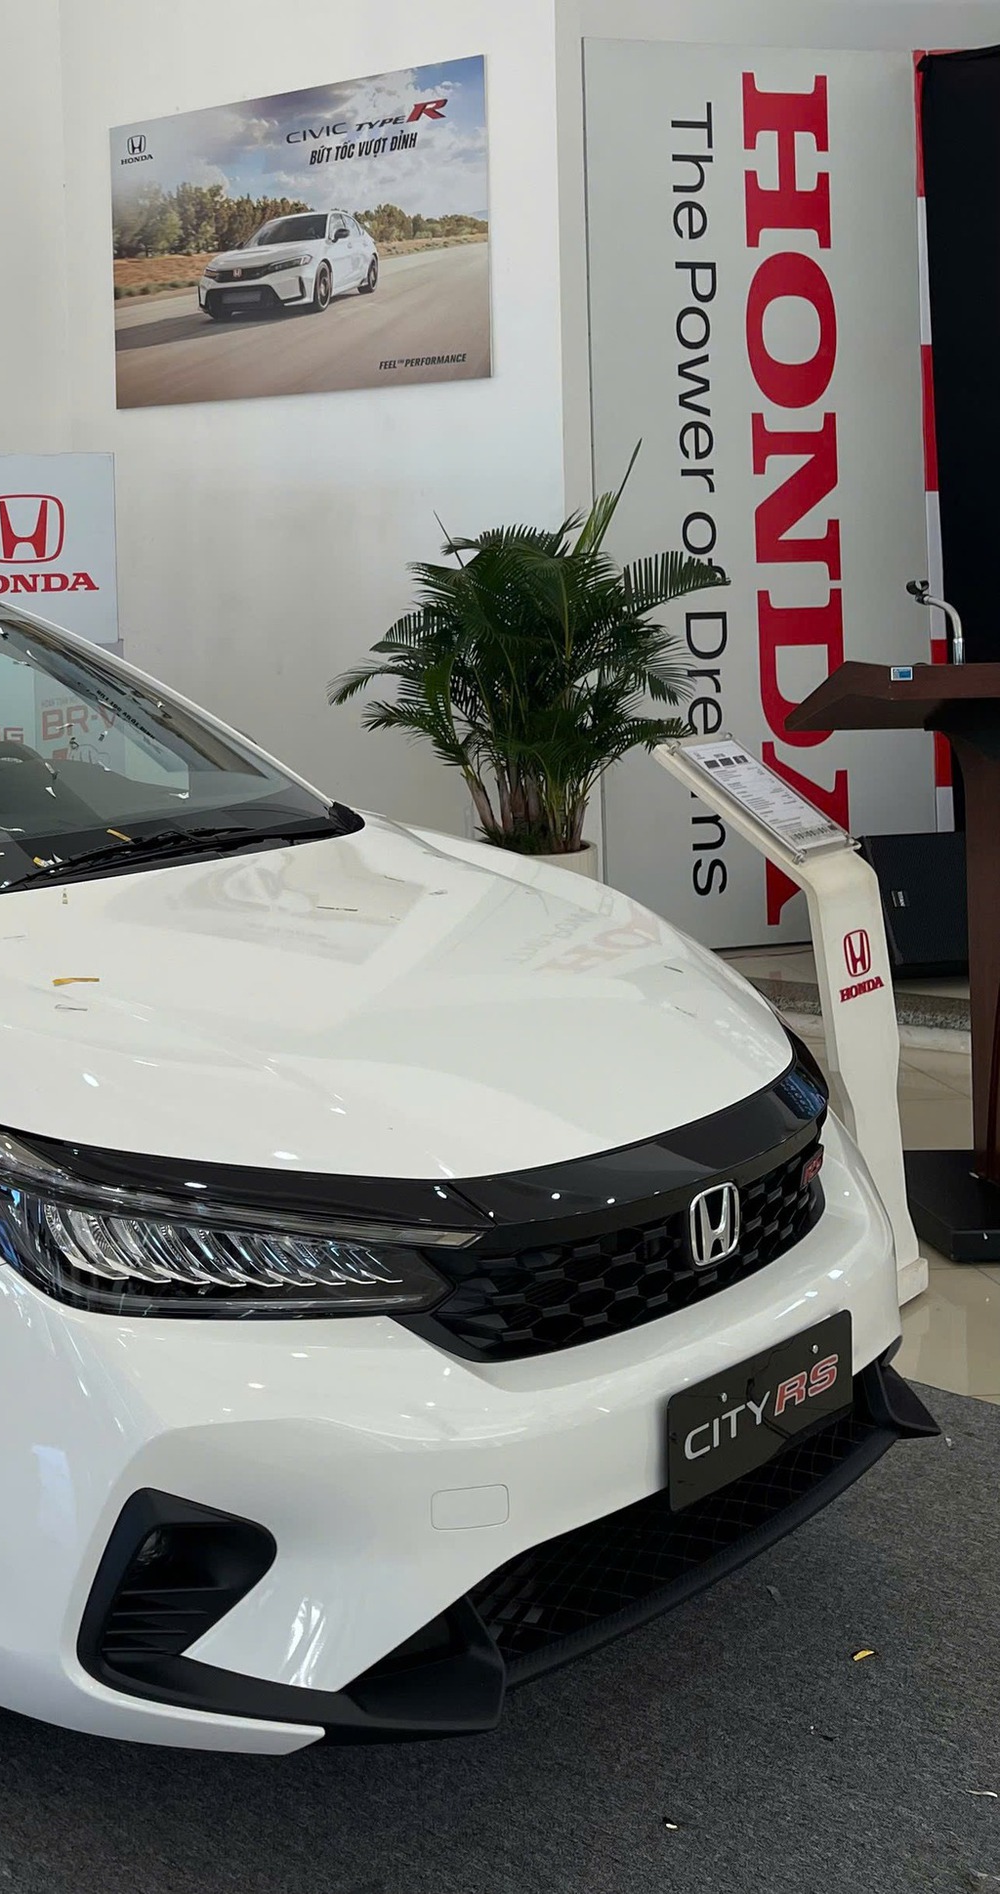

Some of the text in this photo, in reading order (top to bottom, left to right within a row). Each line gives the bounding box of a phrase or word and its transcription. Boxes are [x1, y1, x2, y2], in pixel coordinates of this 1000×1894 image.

[286, 98, 448, 144] CIVIC TYPE R
[120, 153, 153, 165] HONDA
[309, 129, 418, 165] BỨT TỐC VƯỢT ĐỈNH
[671, 101, 713, 240] The
[379, 360, 397, 370] FEEL
[404, 353, 467, 367] PERFORMANCE
[674, 261, 717, 493] Power
[839, 976, 885, 1003] HONDA
[684, 1353, 839, 1460] CITY RS
